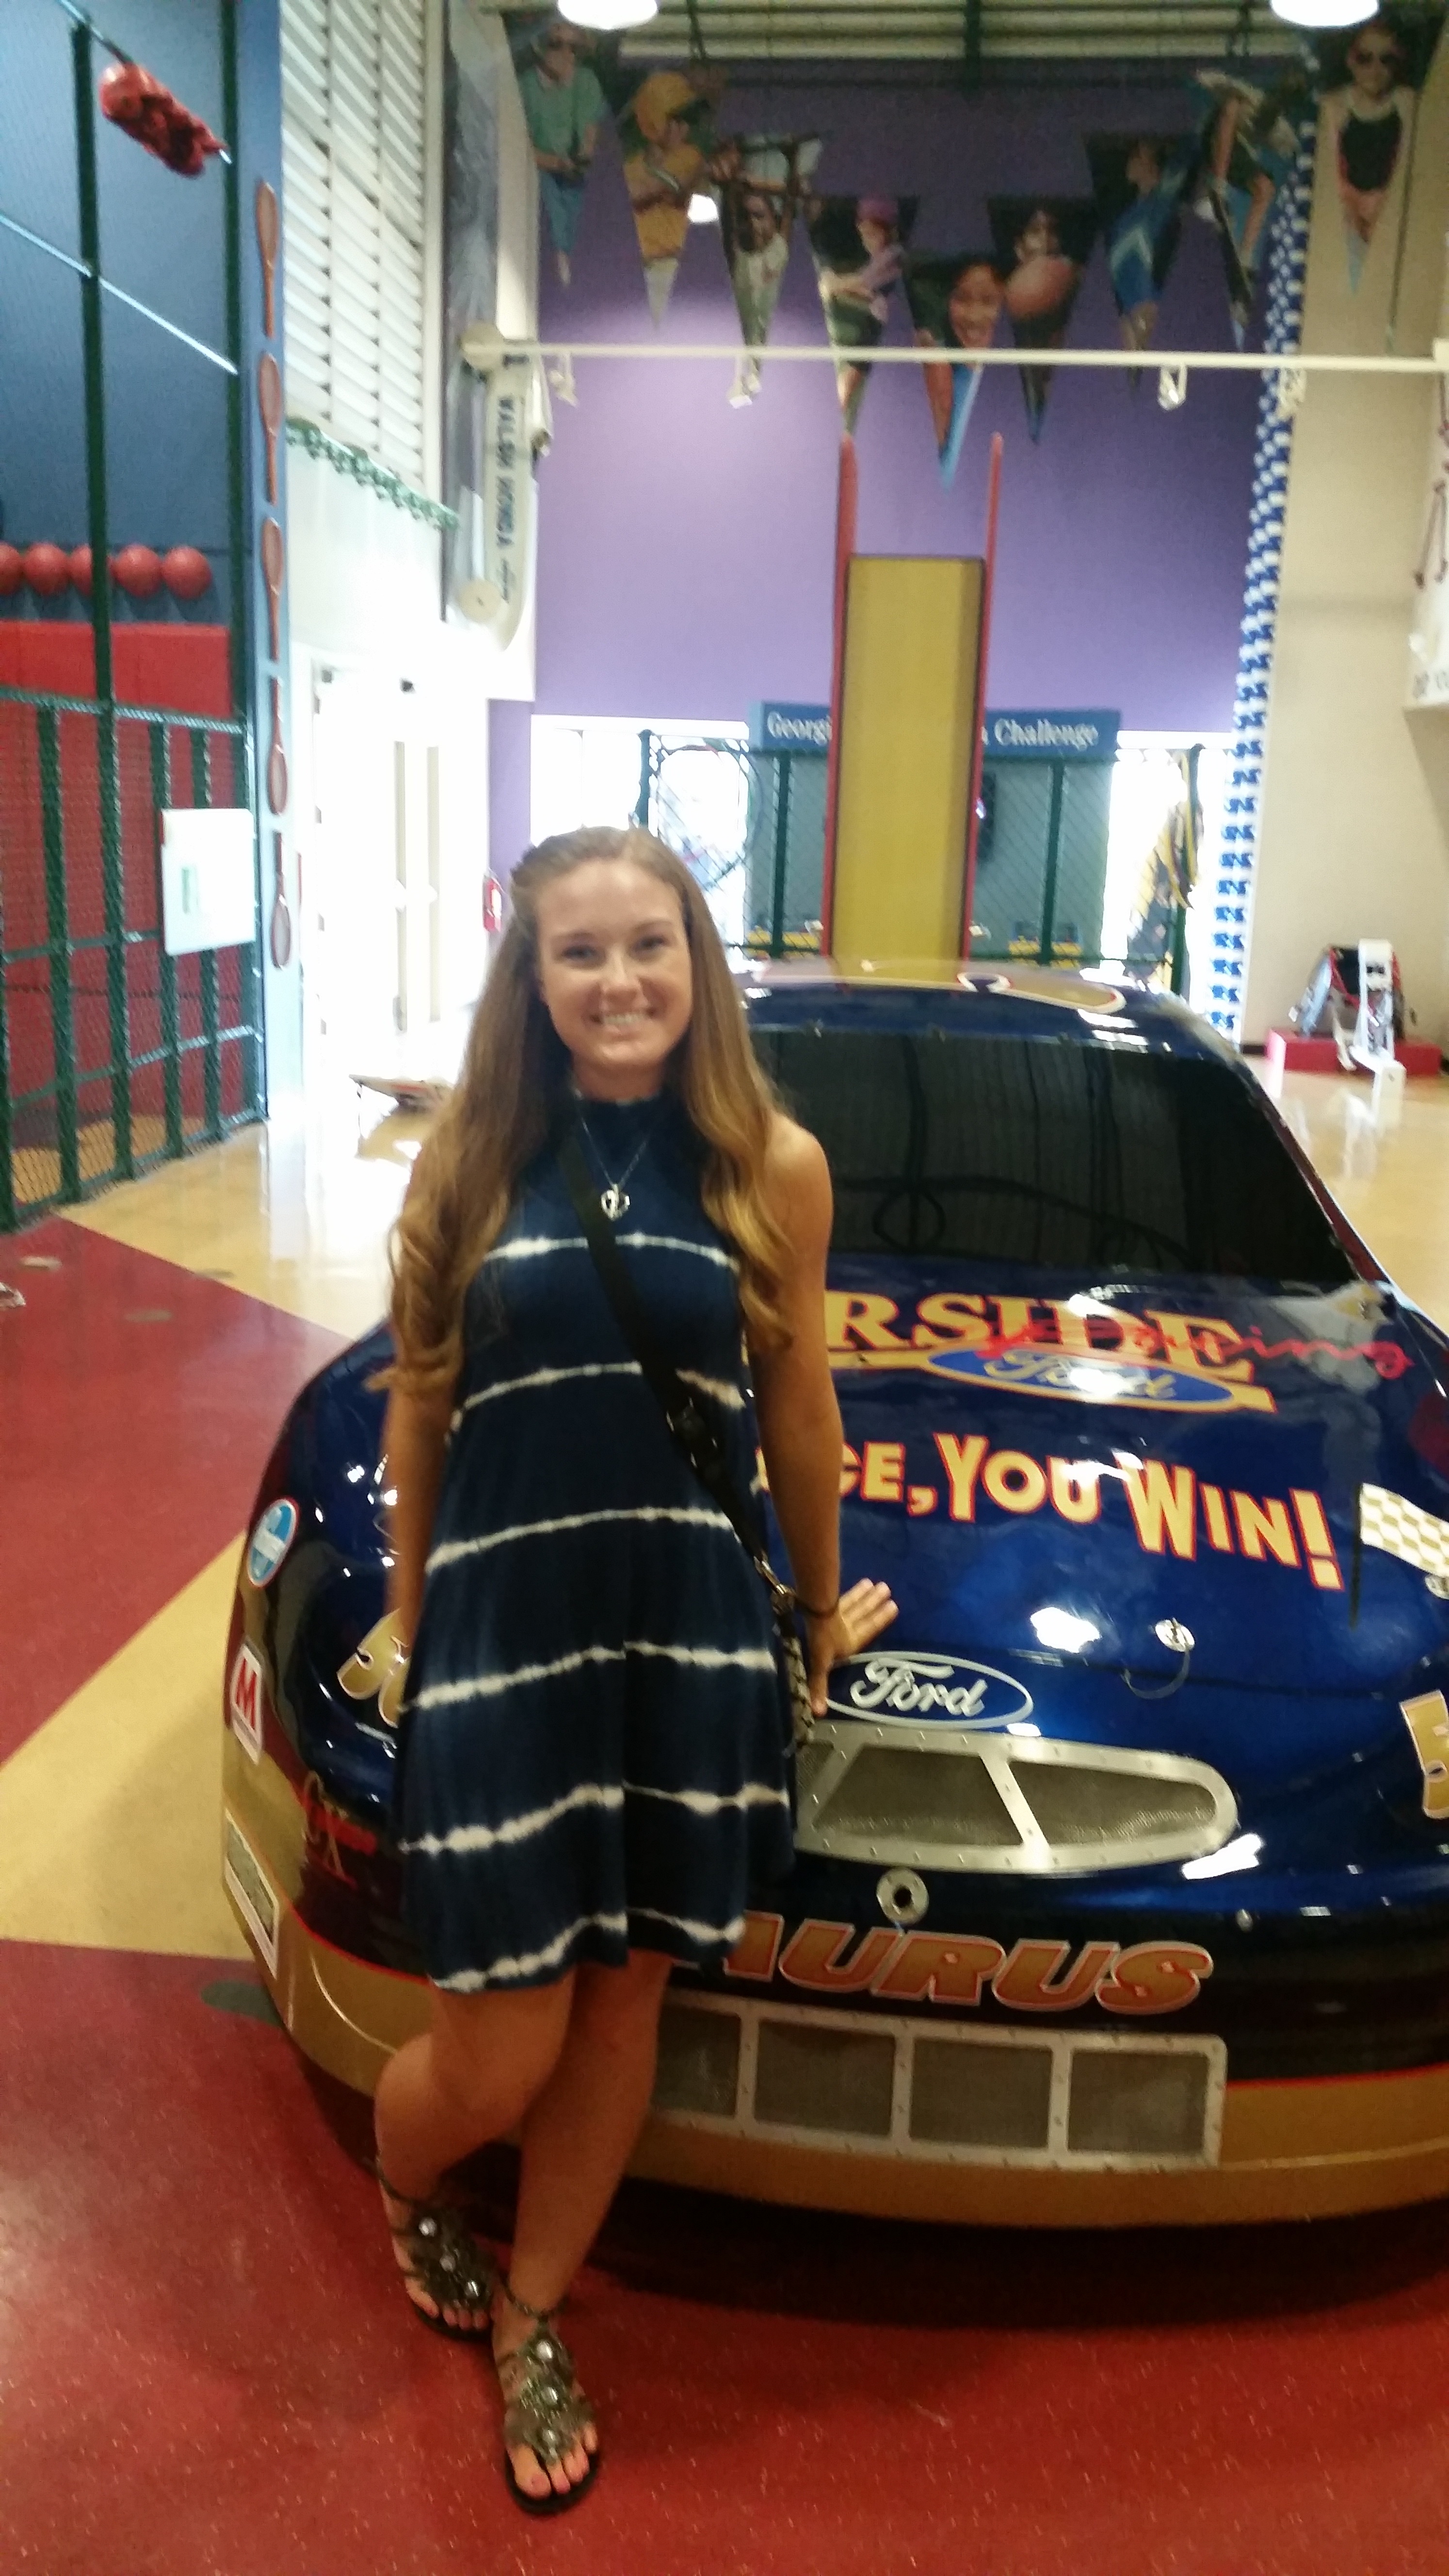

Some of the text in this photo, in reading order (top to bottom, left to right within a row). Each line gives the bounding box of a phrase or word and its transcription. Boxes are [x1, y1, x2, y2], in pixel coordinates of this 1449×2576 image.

[767, 711, 833, 746] Georgi
[994, 718, 1099, 752] Challenge
[825, 1290, 1254, 1384] RSIDE
[983, 1348, 1176, 1396] Fod
[933, 1432, 1102, 1526] YOU
[1110, 1448, 1345, 1591] WIN!
[850, 1656, 989, 1718] Ford
